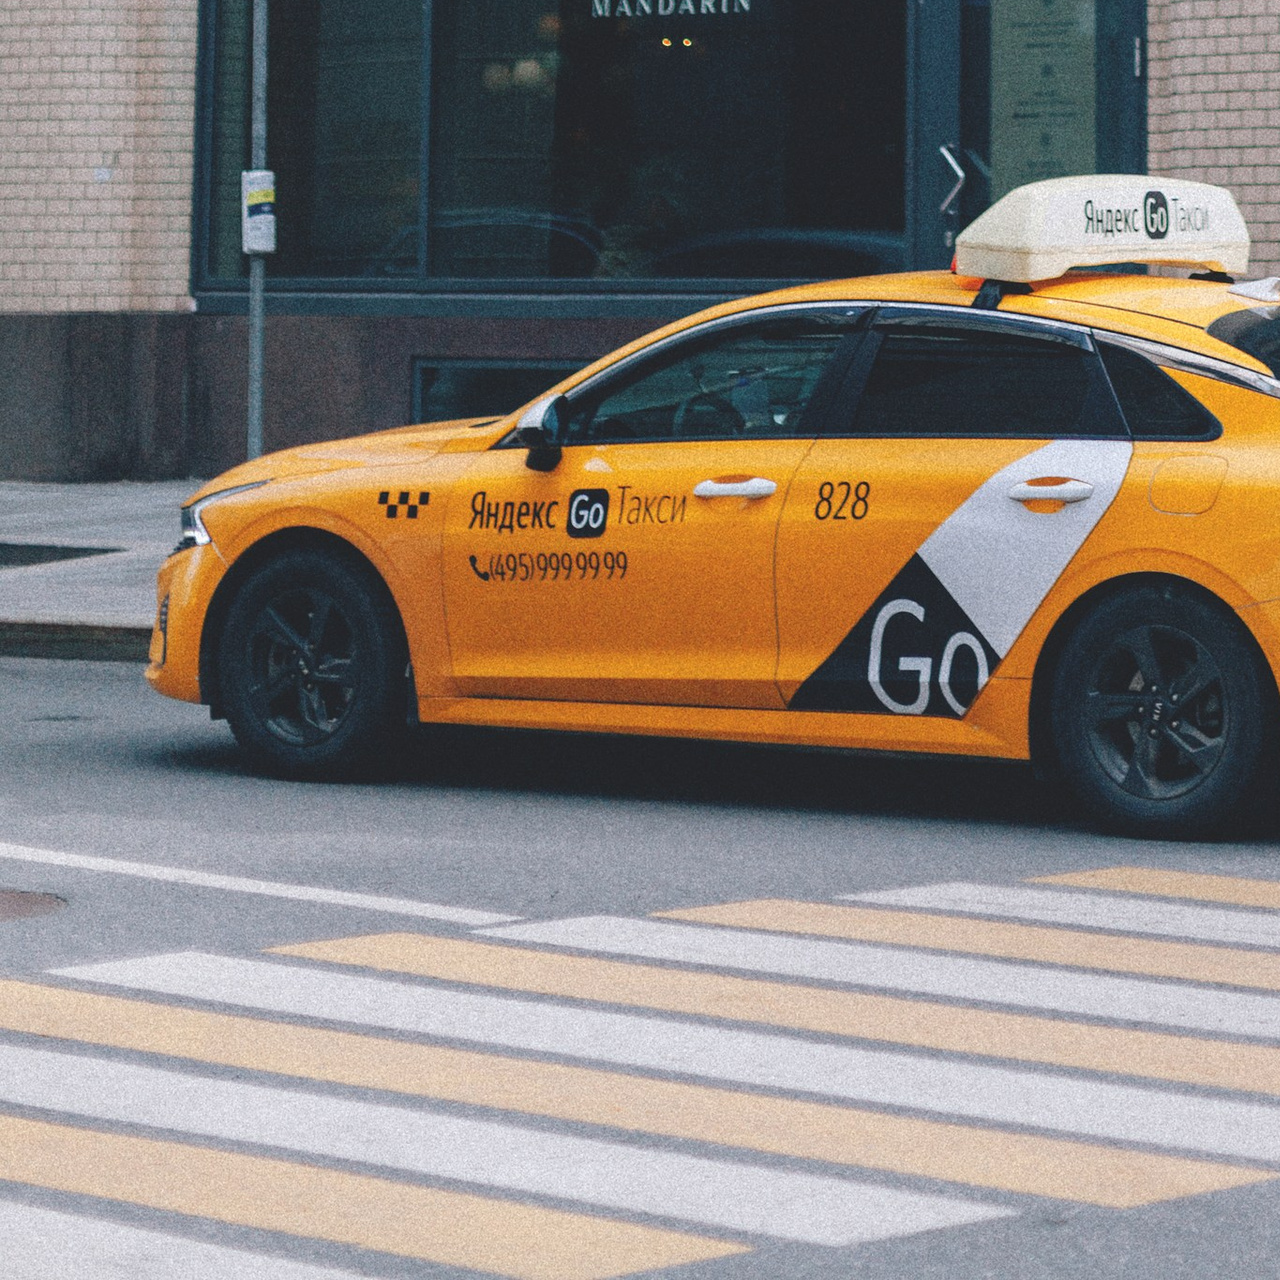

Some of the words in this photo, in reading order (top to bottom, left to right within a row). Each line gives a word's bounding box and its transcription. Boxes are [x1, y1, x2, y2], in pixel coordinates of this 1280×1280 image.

[1084, 199, 1139, 238] Яндекс
[1146, 197, 1168, 233] Go
[1171, 197, 1209, 232] Такси
[468, 490, 558, 535] Яндекс
[570, 493, 603, 529] Go
[616, 485, 689, 526] Такси
[814, 480, 871, 521] 828
[867, 598, 990, 717] Go
